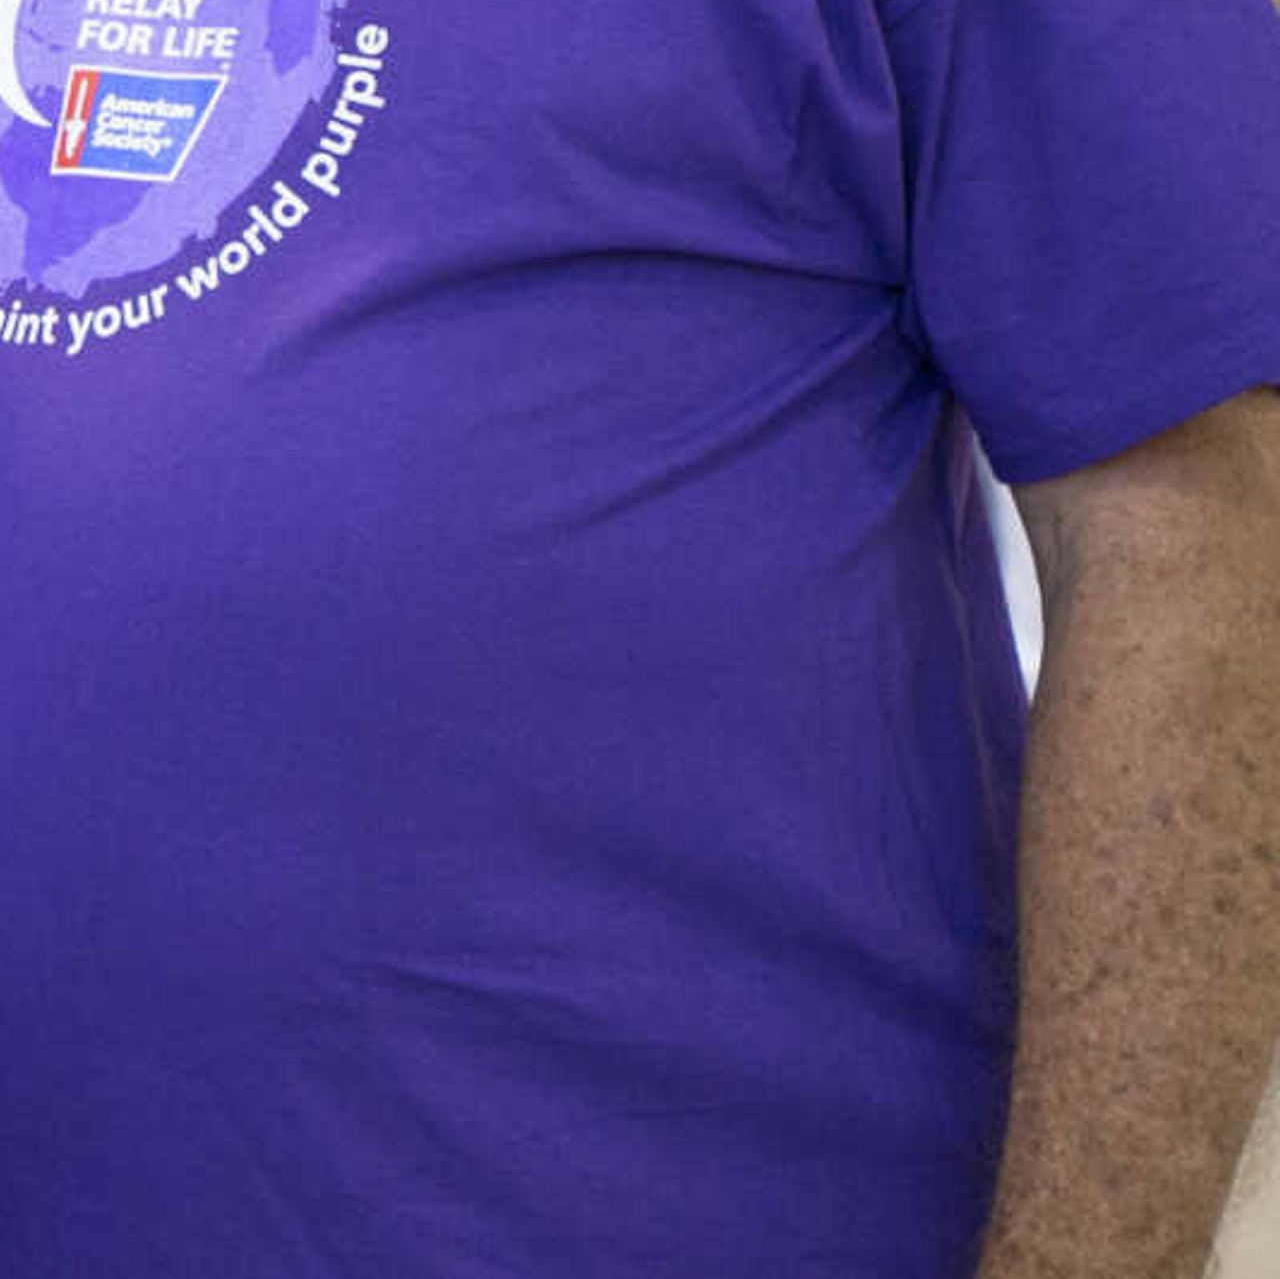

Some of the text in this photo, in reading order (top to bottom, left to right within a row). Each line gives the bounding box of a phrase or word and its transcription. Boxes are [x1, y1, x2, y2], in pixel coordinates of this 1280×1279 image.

[76, 19, 239, 59] FOR LIFE
[100, 92, 196, 118] American
[96, 111, 167, 134] Cancer
[66, 283, 169, 356] your
[175, 179, 311, 301] world
[301, 23, 389, 198] purple
